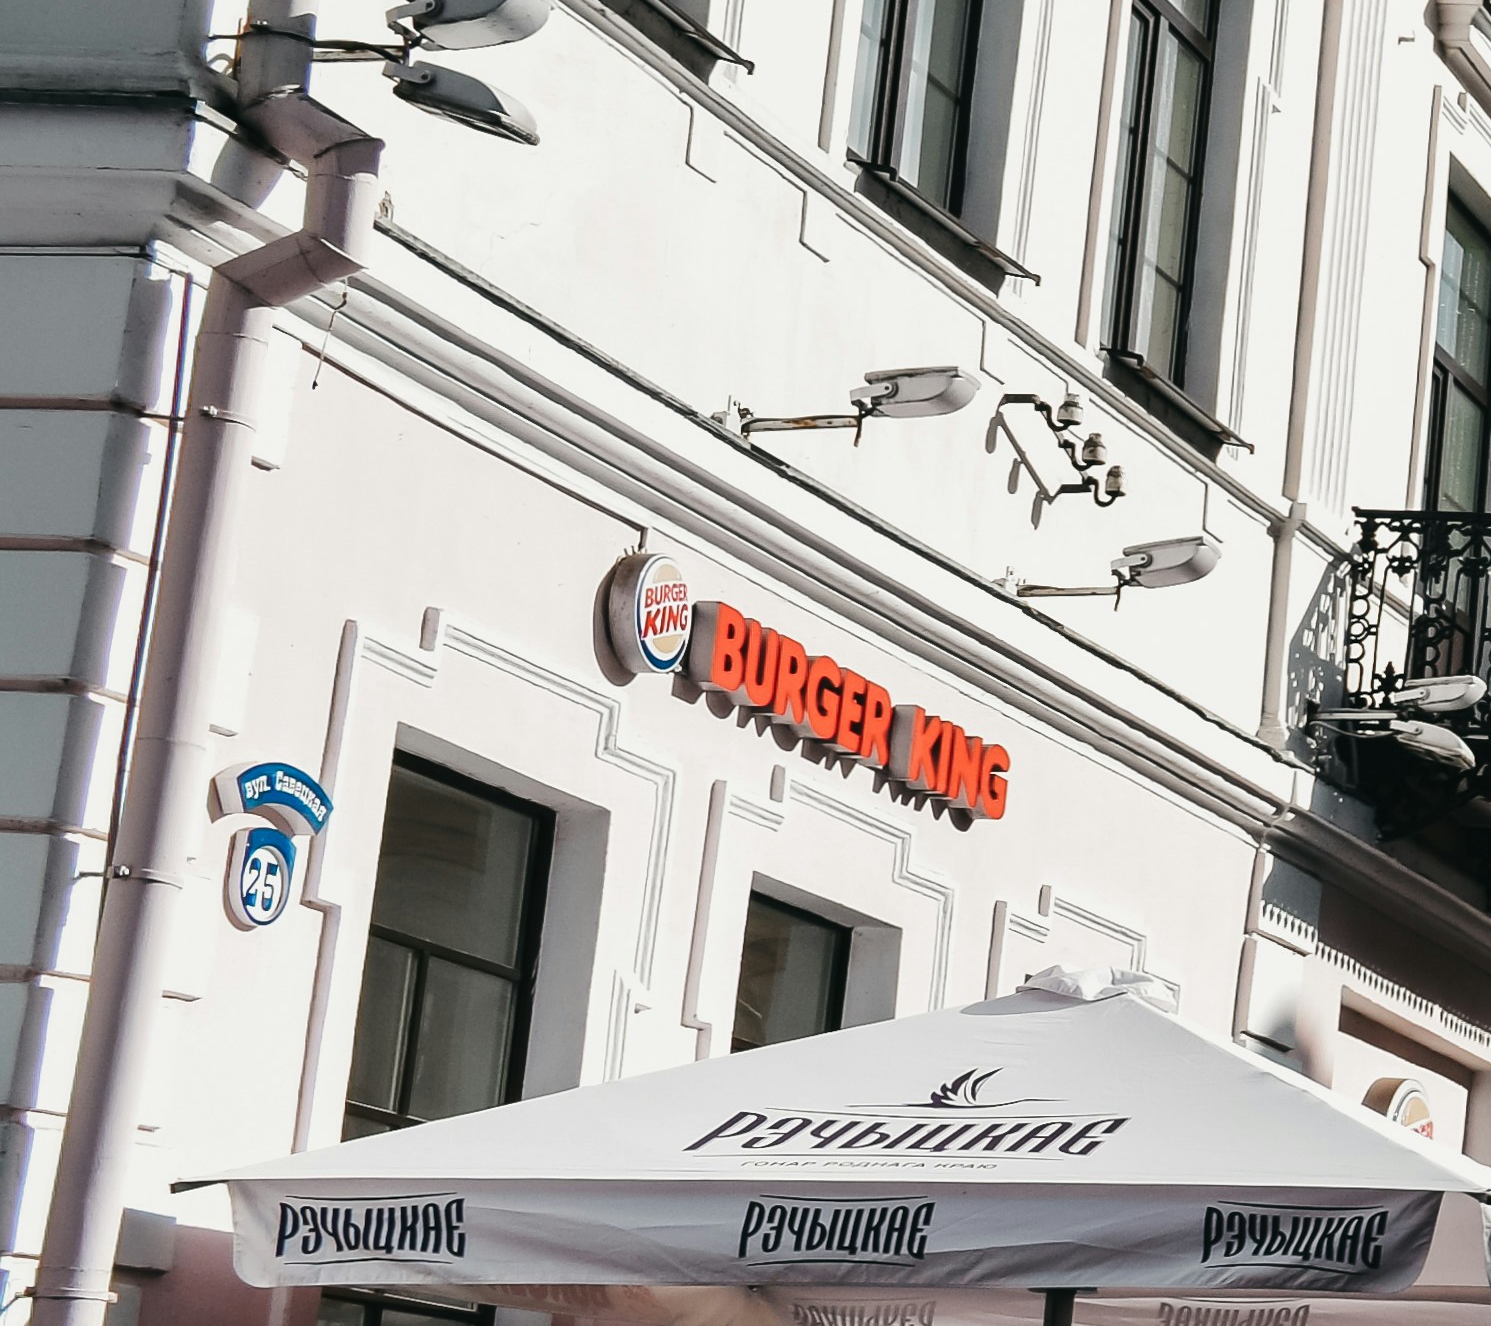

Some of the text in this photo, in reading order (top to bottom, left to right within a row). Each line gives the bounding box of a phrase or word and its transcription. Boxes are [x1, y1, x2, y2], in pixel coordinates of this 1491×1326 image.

[643, 582, 688, 608] BURGER
[641, 603, 689, 640] KING
[711, 601, 1011, 820] BURGER KING
[275, 770, 328, 822] Савецкая
[242, 857, 280, 912] 25
